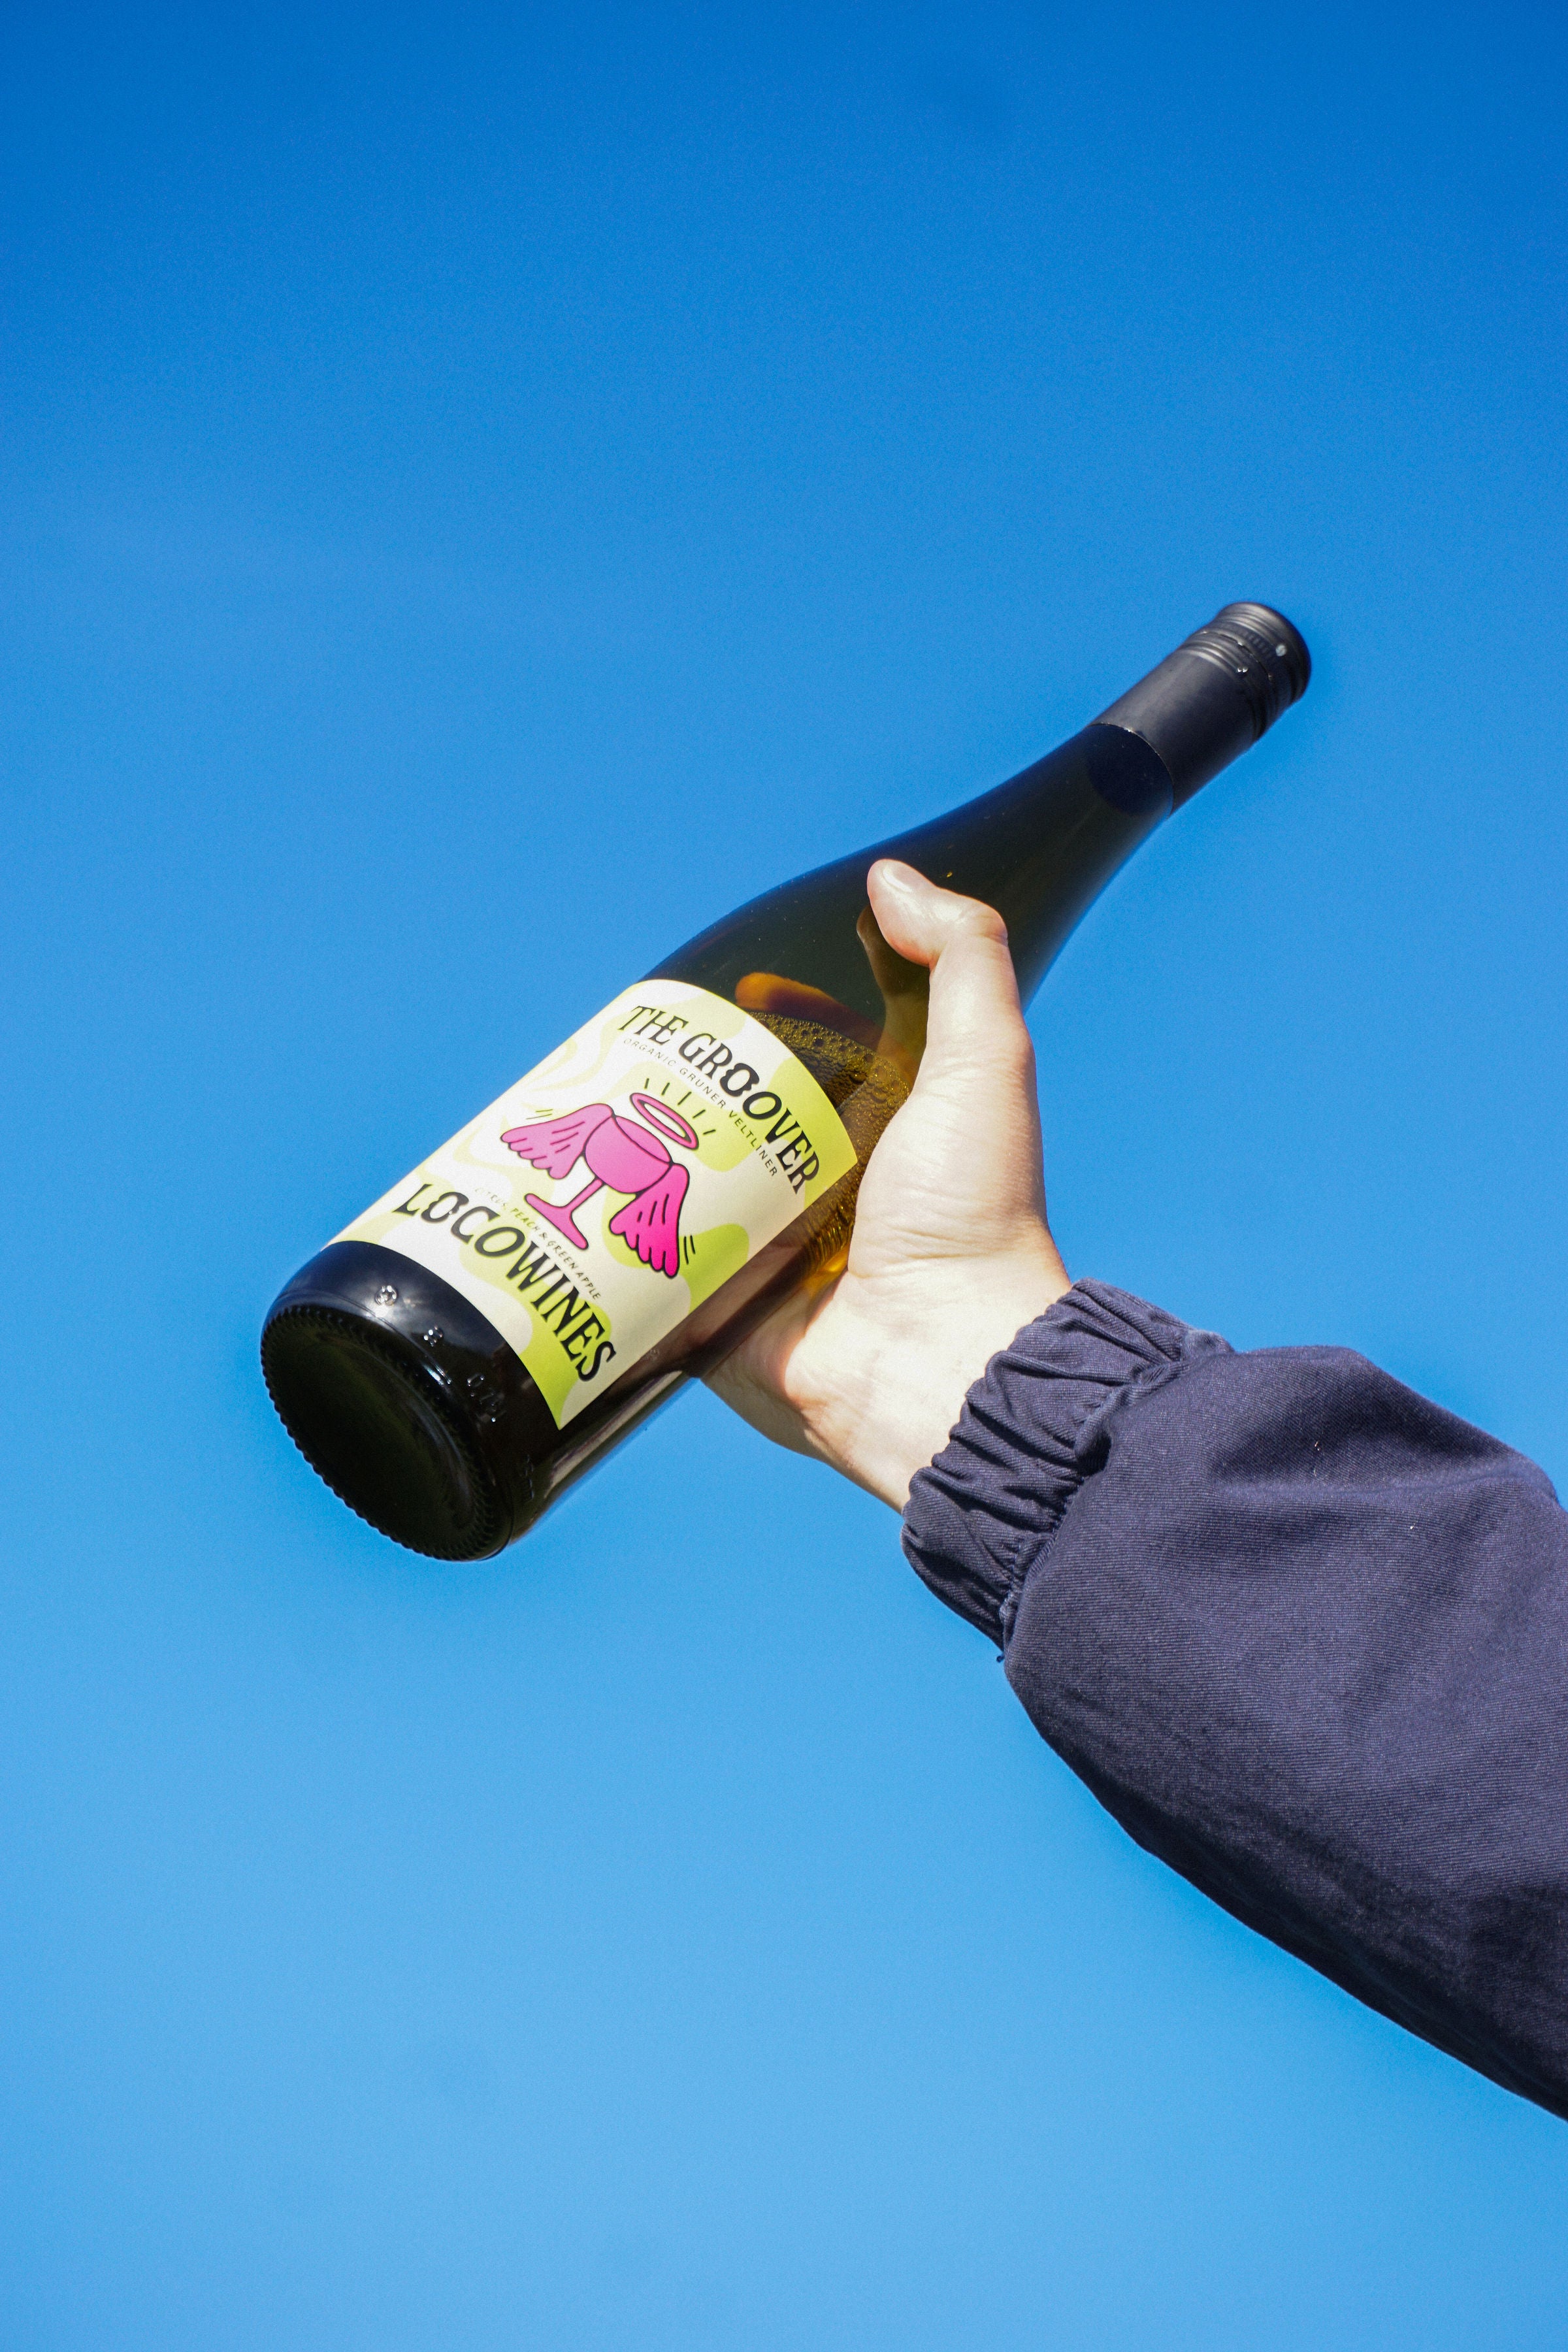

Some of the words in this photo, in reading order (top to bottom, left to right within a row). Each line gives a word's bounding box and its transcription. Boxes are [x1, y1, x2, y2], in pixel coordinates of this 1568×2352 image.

[617, 1005, 689, 1045] THE
[678, 1033, 820, 1194] GROOVER
[623, 1037, 676, 1067] ORGANIC
[679, 1067, 727, 1109] GRUNER
[728, 1109, 777, 1177] VELTLINER
[392, 1183, 617, 1381] LOCOWINES
[510, 1207, 541, 1233] PEACH
[547, 1240, 579, 1271] GREEN
[576, 1271, 602, 1301] APPLE
